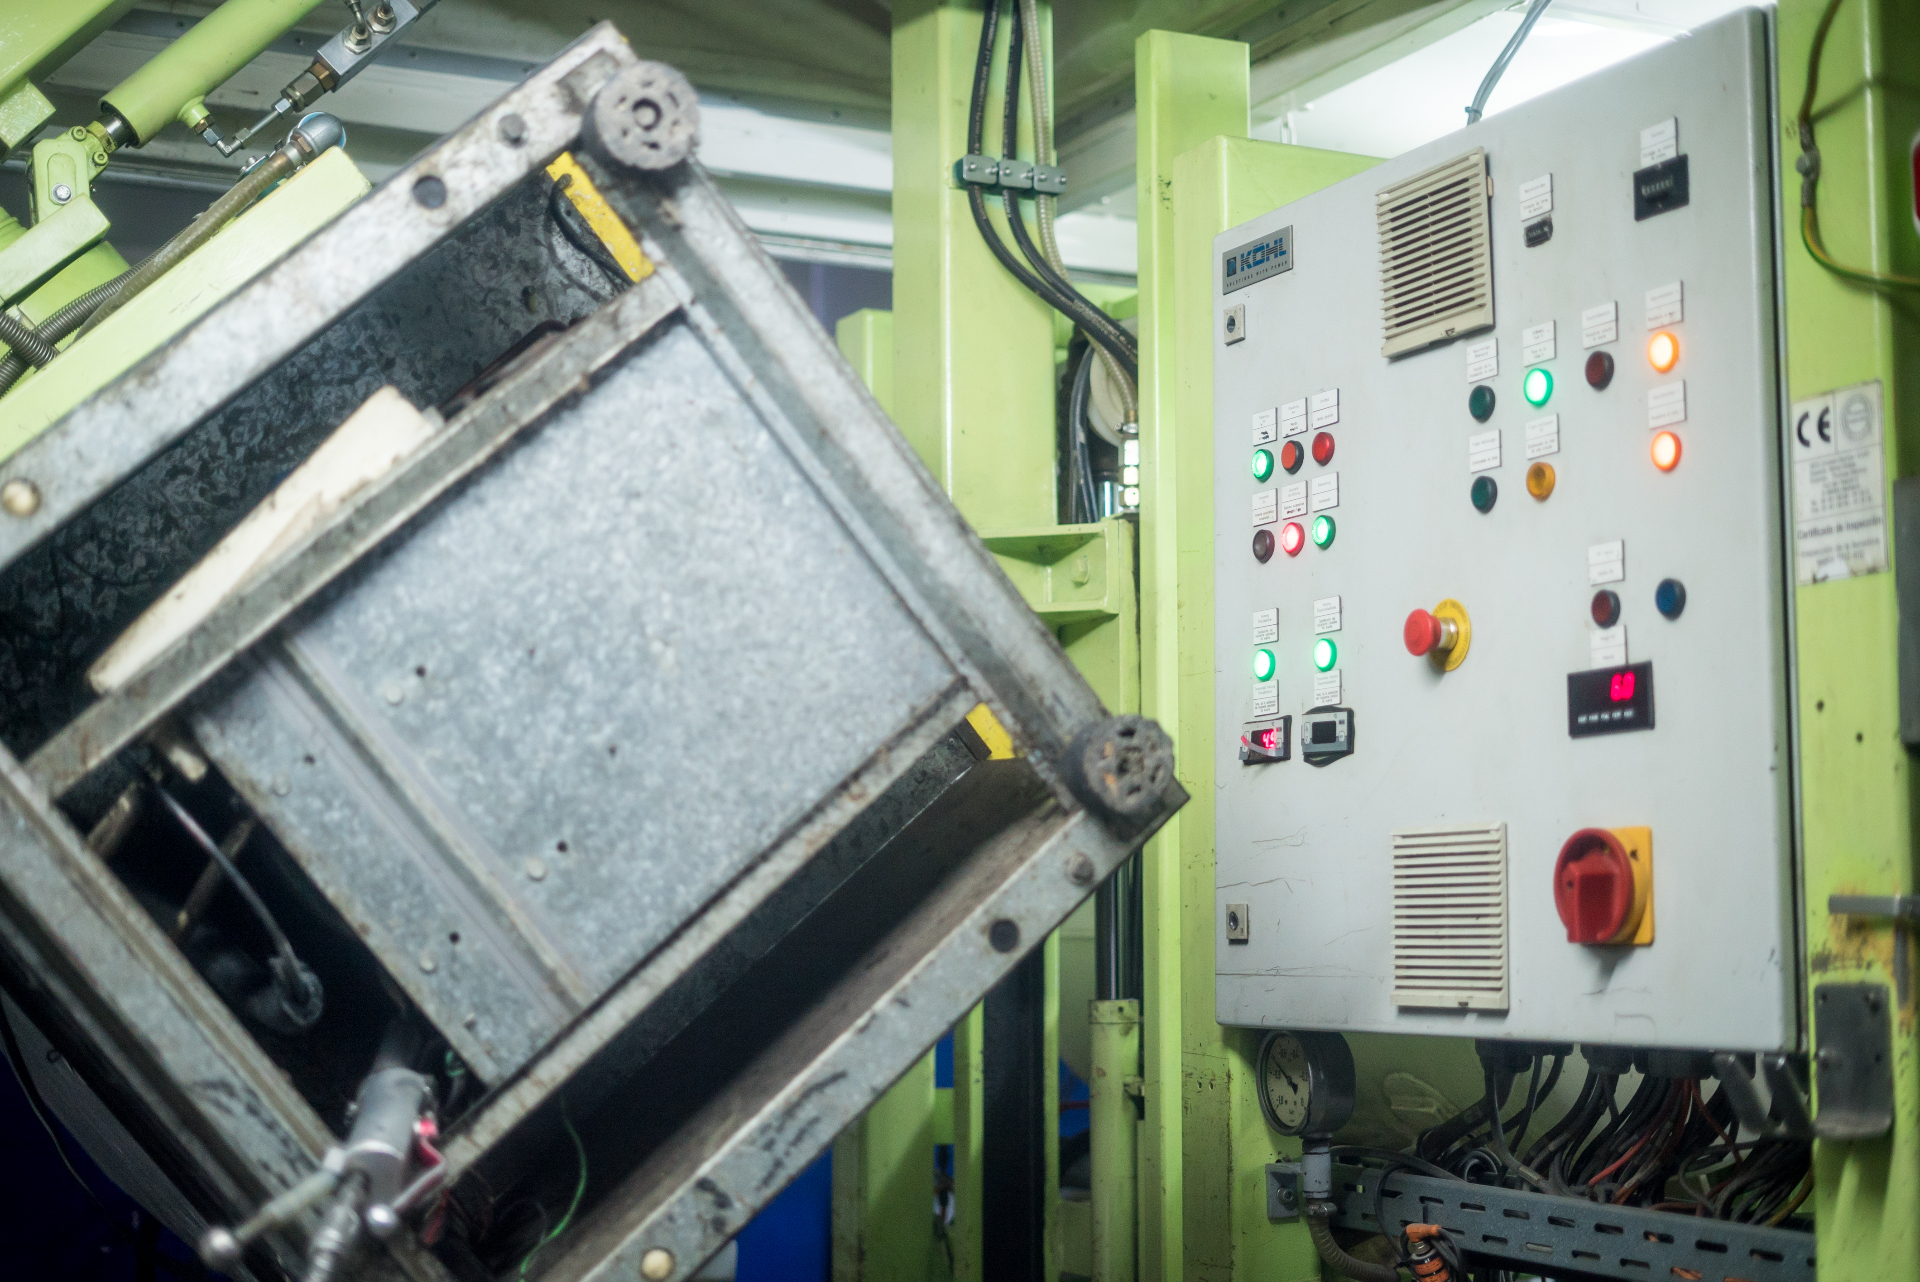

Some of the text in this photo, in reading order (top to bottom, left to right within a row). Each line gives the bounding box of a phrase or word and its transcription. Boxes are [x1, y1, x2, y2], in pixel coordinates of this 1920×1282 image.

[1241, 237, 1286, 272] KÖHL
[1227, 260, 1287, 287] SOLUTIONS WITH POWER
[1797, 406, 1831, 448] CE
